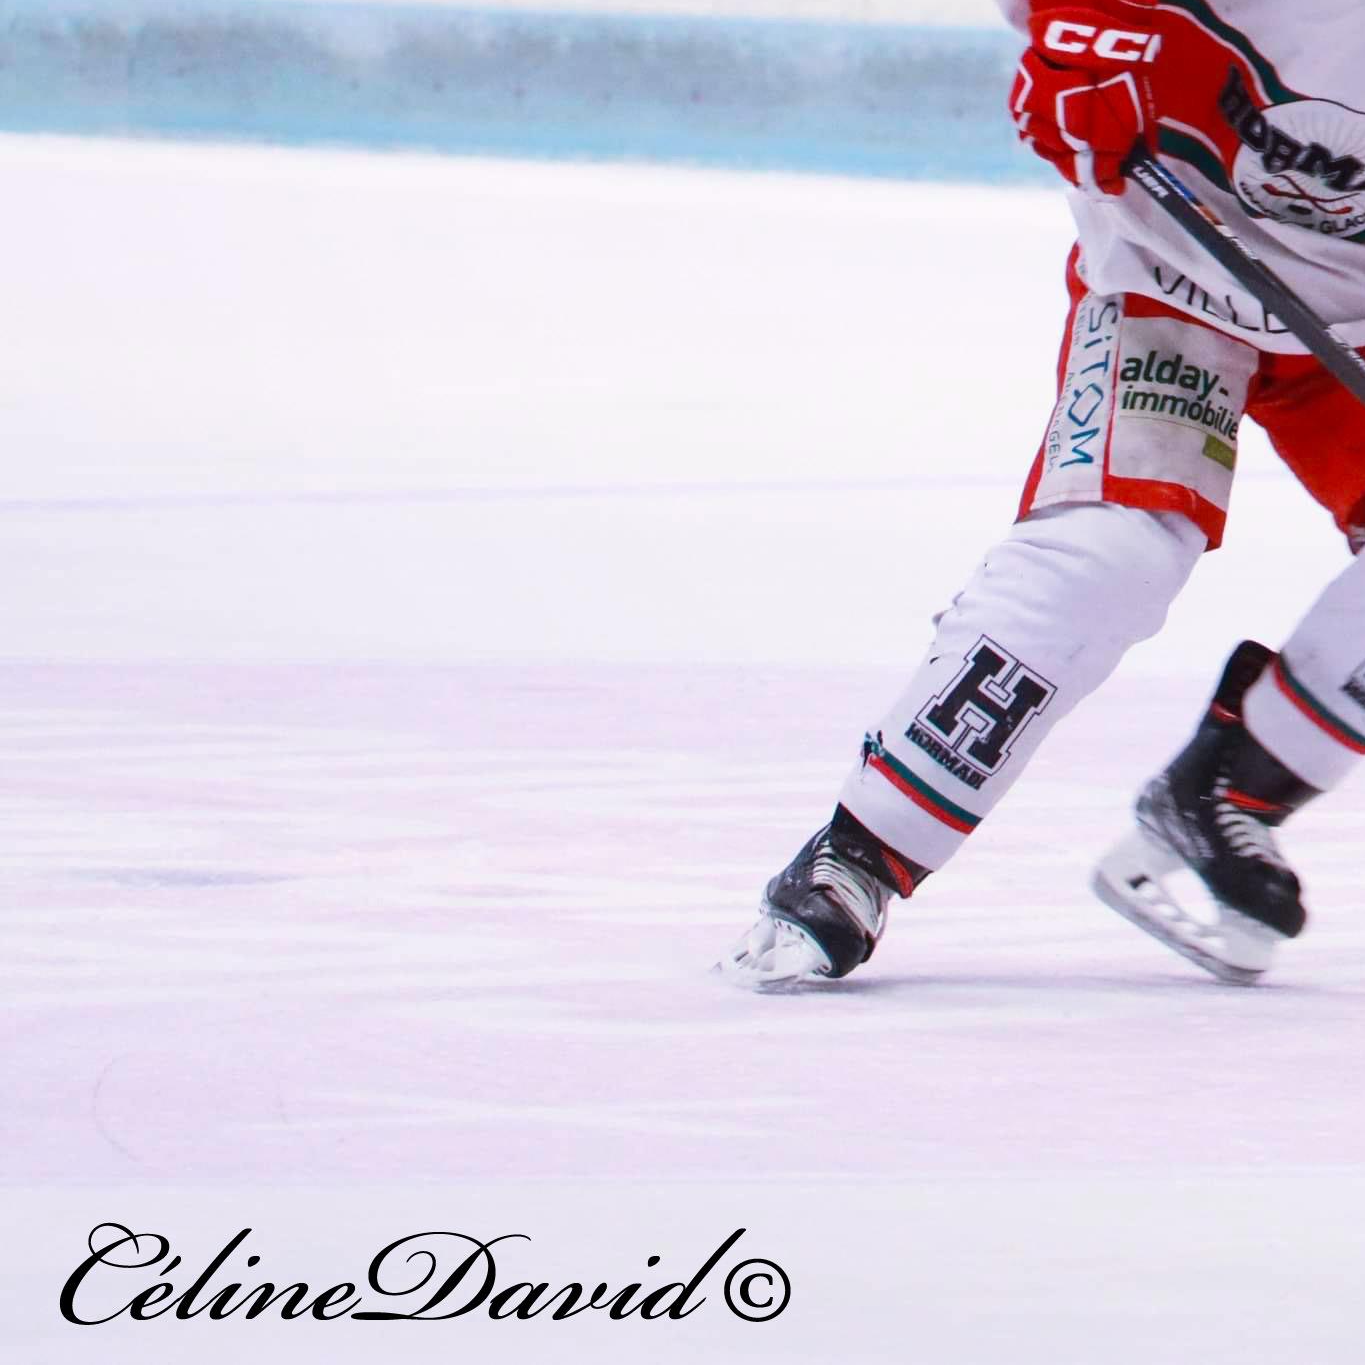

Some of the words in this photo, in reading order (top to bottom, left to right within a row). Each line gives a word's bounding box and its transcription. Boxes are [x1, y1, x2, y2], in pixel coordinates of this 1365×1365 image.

[1119, 351, 1230, 401] alday-
[1121, 385, 1240, 442] immobilie
[914, 633, 1058, 777] H
